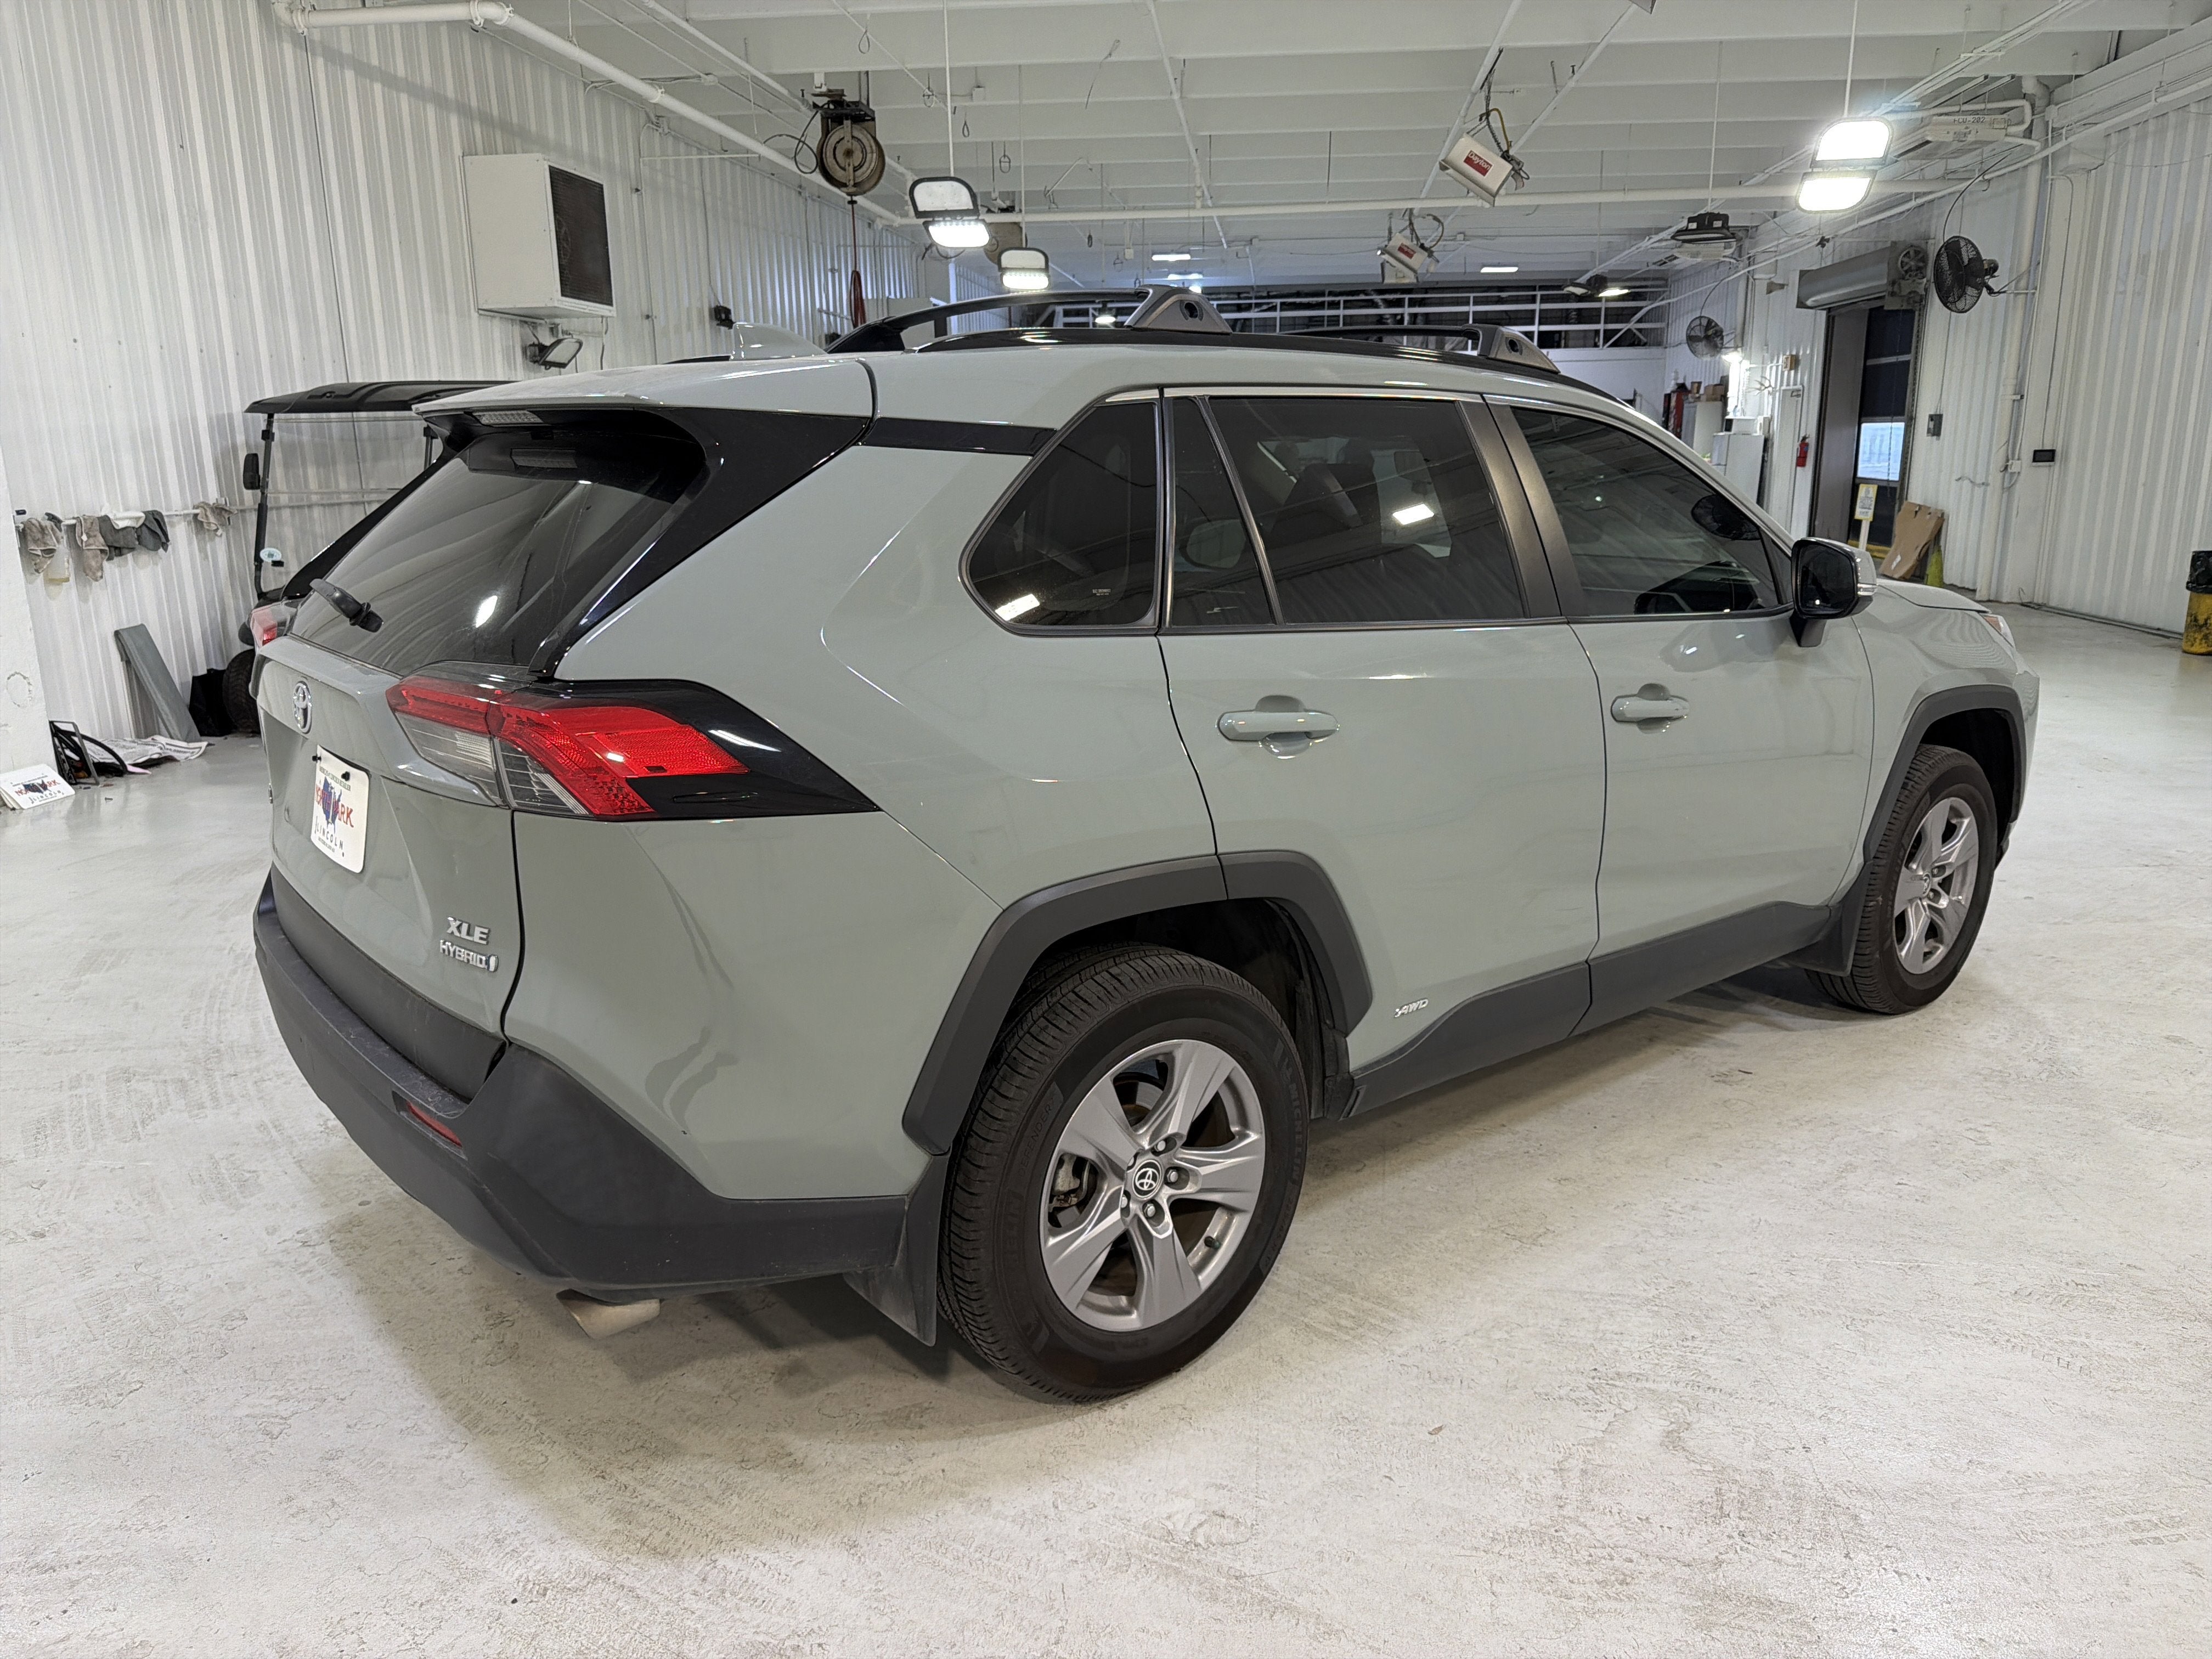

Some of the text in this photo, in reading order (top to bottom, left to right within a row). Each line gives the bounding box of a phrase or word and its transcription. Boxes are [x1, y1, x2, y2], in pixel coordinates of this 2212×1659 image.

[1468, 151, 1491, 171] Dayton
[317, 822, 343, 850] LINCOLN
[447, 917, 490, 945] XLE
[439, 939, 488, 970] HYBRID
[1401, 998, 1429, 1014] AWD
